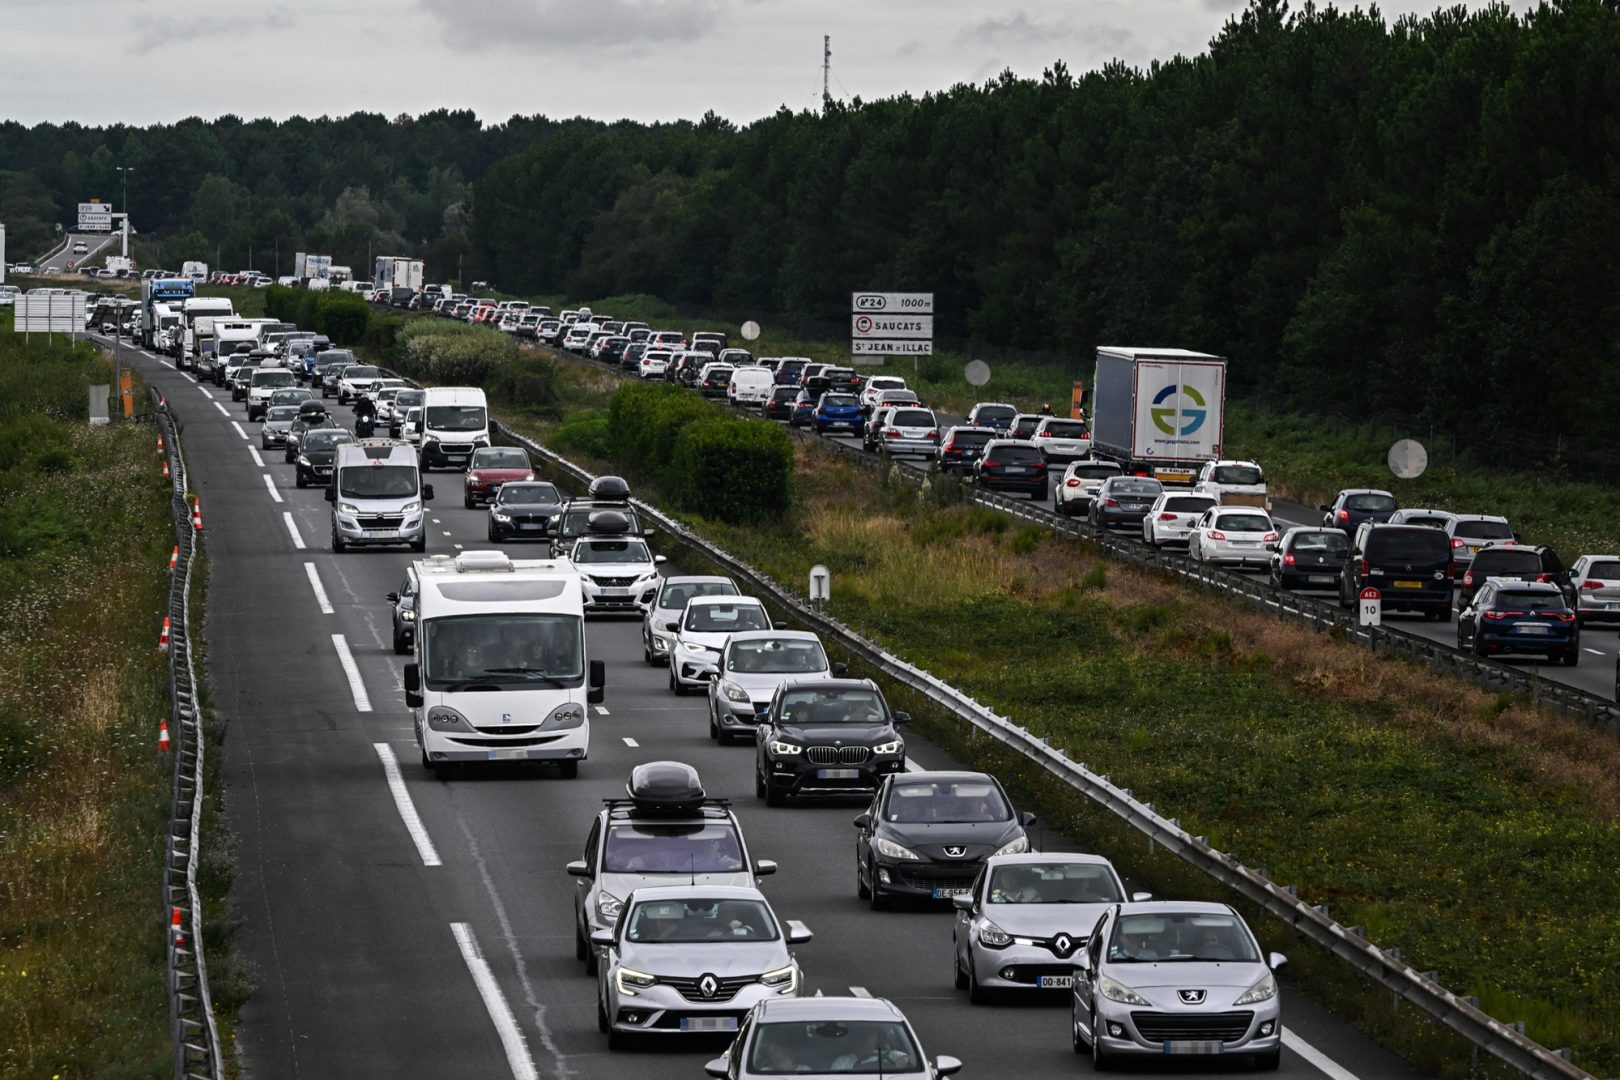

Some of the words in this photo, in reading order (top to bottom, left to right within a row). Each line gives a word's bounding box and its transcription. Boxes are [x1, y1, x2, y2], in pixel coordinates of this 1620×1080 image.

[875, 322, 922, 331] SAUCATS
[868, 343, 893, 352] JEAN
[1364, 605, 1376, 615] 10
